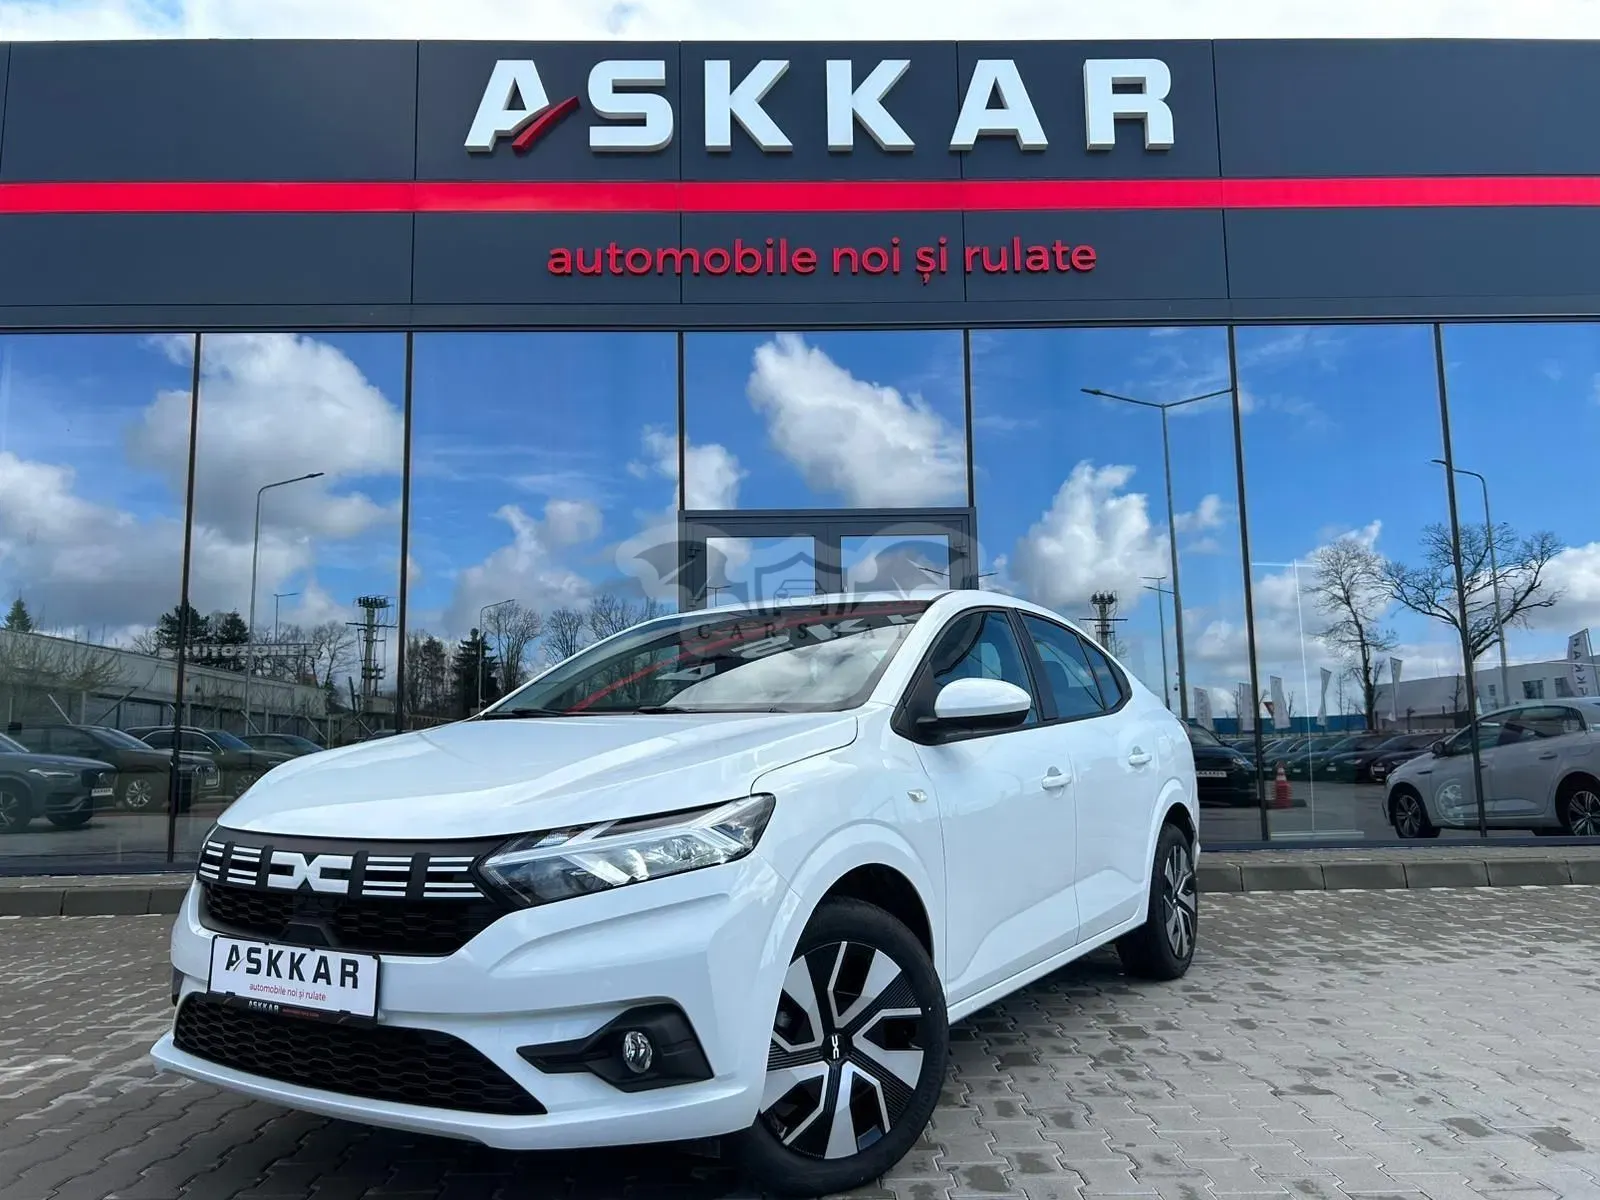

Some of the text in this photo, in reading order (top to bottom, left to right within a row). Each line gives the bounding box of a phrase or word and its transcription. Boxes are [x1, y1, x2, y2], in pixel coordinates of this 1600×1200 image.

[464, 58, 1175, 153] ASKKAR
[547, 235, 1098, 286] automobile noi și rulate
[225, 944, 360, 989] ASKKAR
[249, 983, 286, 996] automobile
[287, 988, 298, 998] noi
[305, 991, 327, 1001] rulate
